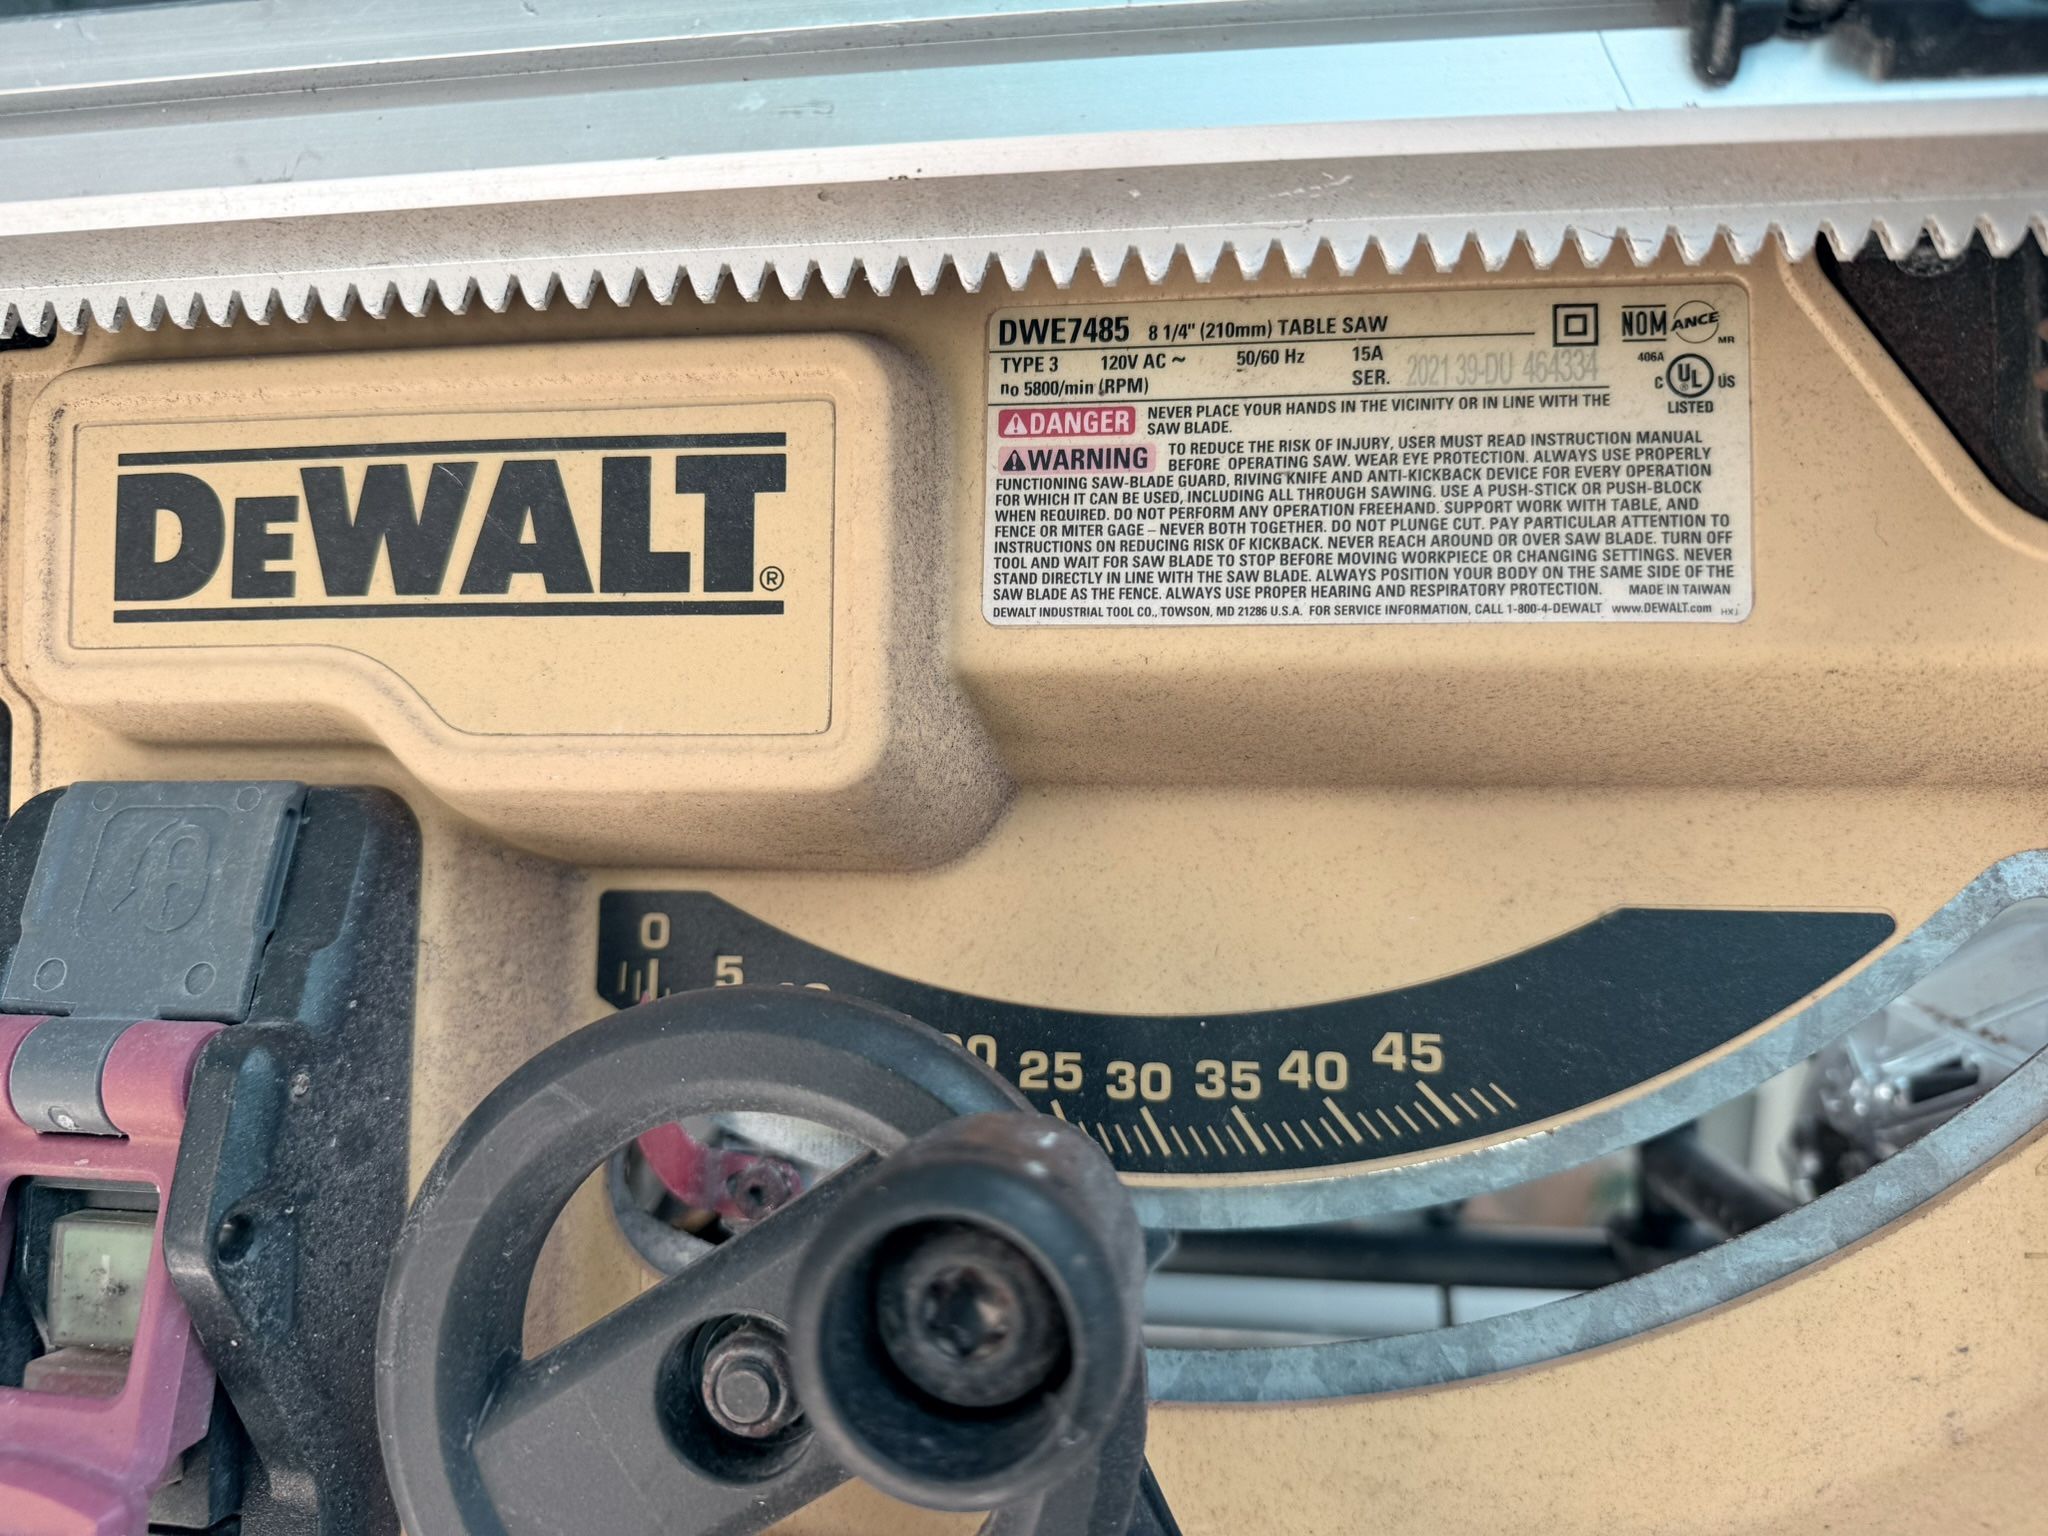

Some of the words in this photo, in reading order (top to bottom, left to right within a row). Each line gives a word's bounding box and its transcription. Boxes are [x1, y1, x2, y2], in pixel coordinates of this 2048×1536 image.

[999, 316, 1128, 346] DWE7485
[1148, 324, 1157, 342] 8
[1163, 323, 1195, 341] 1/4"
[1200, 320, 1272, 340] (210mm)
[1277, 317, 1335, 336] TABLE
[1342, 316, 1387, 334] SAW
[1622, 310, 1666, 336] NOM
[1671, 311, 1719, 331] ANCE
[1718, 336, 1735, 344] MR
[1000, 357, 1043, 373] TYPE
[1049, 357, 1057, 372] 3
[1101, 355, 1138, 370] 120V
[1143, 354, 1165, 369] AC
[1237, 350, 1279, 366] 50/60
[1285, 350, 1304, 365] Hz
[1352, 346, 1382, 362] 15A
[1637, 352, 1664, 362] 406A
[1024, 380, 1093, 396] 5800/min
[1098, 379, 1148, 395] (RPM)
[1352, 370, 1389, 385] SER.
[1718, 376, 1735, 388] US
[1148, 406, 1191, 420] NEVER
[1196, 404, 1239, 418] PLACE
[1243, 403, 1281, 417] YOUR
[1286, 402, 1336, 416] HANDS
[1340, 401, 1355, 414] IN
[1360, 400, 1386, 413] THE
[1391, 399, 1453, 413] VICINITY
[1458, 398, 1477, 411] OR
[1482, 398, 1497, 410] IN
[1502, 397, 1533, 409] LINE
[1538, 396, 1577, 408] WITH
[1582, 395, 1609, 407] THE
[1668, 400, 1714, 414] LISTED
[1029, 409, 1130, 435] DANGER
[1147, 422, 1180, 435] SAW
[1184, 421, 1231, 434] BLADE.
[1168, 443, 1185, 455] TO
[1190, 441, 1243, 454] REDUCE
[1248, 441, 1273, 453] THE
[1279, 440, 1310, 453] RISK
[1315, 440, 1332, 452] OF
[1336, 438, 1393, 451] INJURY,
[1398, 437, 1435, 450] USER
[1440, 436, 1482, 449] MUST
[1487, 435, 1525, 448] READ
[1531, 433, 1630, 447] INSTRUCTION
[1636, 432, 1702, 445] MANUAL
[1027, 446, 1149, 471] WARNING
[996, 476, 1086, 490] FUNCTIONING
[1091, 475, 1173, 488] SAW-BLADE
[1178, 474, 1229, 487] GUARD,
[1234, 473, 1282, 485] RIVING
[1286, 472, 1326, 484] KNIFE
[1331, 471, 1362, 484] AND
[1366, 469, 1480, 483] ANTI-KICKBACK
[1486, 468, 1537, 481] DEVICE
[1542, 467, 1569, 479] FOR
[1575, 467, 1620, 479] EVERY
[1626, 465, 1710, 478] OPERATION
[995, 509, 1035, 522] WHEN
[1040, 508, 1109, 521] REQUIRED.
[1114, 508, 1132, 520] DO
[1137, 507, 1165, 519] NOT
[1169, 506, 1234, 519] PERFORM
[1238, 505, 1268, 518] ANY
[1273, 504, 1354, 517] OPERATION
[1359, 503, 1438, 516] FREEHAND.
[1444, 501, 1512, 514] SUPPORT
[1516, 501, 1561, 513] WORK
[1566, 500, 1606, 512] WITH
[1611, 499, 1660, 511] TABLE,
[1666, 499, 1698, 511] AND
[995, 525, 1035, 537] FENCE
[1040, 525, 1057, 537] OR
[1062, 524, 1102, 536] MITER
[1107, 524, 1143, 536] GAGE
[1160, 523, 1203, 535] NEVER
[1209, 522, 1245, 534] BOTH
[1250, 521, 1326, 533] TOGETHER.
[1331, 520, 1350, 532] DO
[1356, 520, 1385, 532] NOT
[1390, 519, 1447, 531] PLUNGE
[1453, 518, 1484, 530] CUT.
[1489, 518, 1518, 530] PAY
[1524, 517, 1615, 529] PARTICULAR
[1621, 515, 1705, 528] ATTENTION
[1711, 515, 1728, 527] TO
[993, 557, 1026, 569] TOOL
[1030, 556, 1059, 569] AND
[1063, 556, 1099, 568] WAIT
[1103, 556, 1127, 568] FOR
[1132, 555, 1165, 567] SAW
[1169, 555, 1212, 567] BLADE
[1217, 554, 1234, 567] TO
[1239, 554, 1275, 566] STOP
[1280, 553, 1332, 566] BEFORE
[1337, 553, 1396, 565] MOVING
[1401, 552, 1487, 565] WORKPIECE
[1492, 551, 1511, 564] OR
[1517, 550, 1596, 563] CHANGING
[1602, 549, 1677, 562] SETTINGS.
[1684, 549, 1731, 561] NEVER
[993, 588, 1023, 600] SAW
[1026, 588, 1066, 600] BLADE
[1070, 588, 1087, 600] AS
[1091, 587, 1114, 600] THE
[1119, 587, 1161, 600] FENCE.
[1165, 587, 1221, 599] ALWAYS
[1225, 586, 1250, 599] USE
[1255, 586, 1306, 599] PROPER
[1311, 586, 1370, 598] HEARING
[1375, 585, 1405, 598] AND
[1410, 585, 1505, 598] RESPIRATORY
[1510, 584, 1601, 597] PROTECTION.
[1629, 584, 1662, 595] MADE
[1667, 584, 1678, 595] IN
[1682, 584, 1730, 595] TAIWAN
[993, 607, 1036, 618] DEWALT
[1039, 607, 1103, 617] INDUSTRIAL
[1106, 606, 1133, 617] TOOL
[1137, 606, 1157, 617] CO.,
[1160, 606, 1212, 617] TOWSON,
[1216, 606, 1234, 616] MD
[1238, 605, 1267, 616] 21286
[1270, 605, 1302, 616] U.S.A.
[1309, 605, 1330, 616] FOR
[1334, 605, 1380, 616] SERVICE
[1385, 604, 1470, 615] INFORMATION,
[1475, 604, 1503, 615] CALL
[1507, 603, 1601, 614] 1-800-4-DEWALT
[1611, 603, 1711, 613] www.DEWALT.com
[640, 912, 670, 950] 0
[714, 954, 745, 987] 5
[1371, 1033, 1445, 1073] 45
[1018, 1051, 1083, 1092] 25
[1105, 1061, 1172, 1102] 30
[1195, 1060, 1262, 1101] 35
[1278, 1051, 1348, 1093] 40
